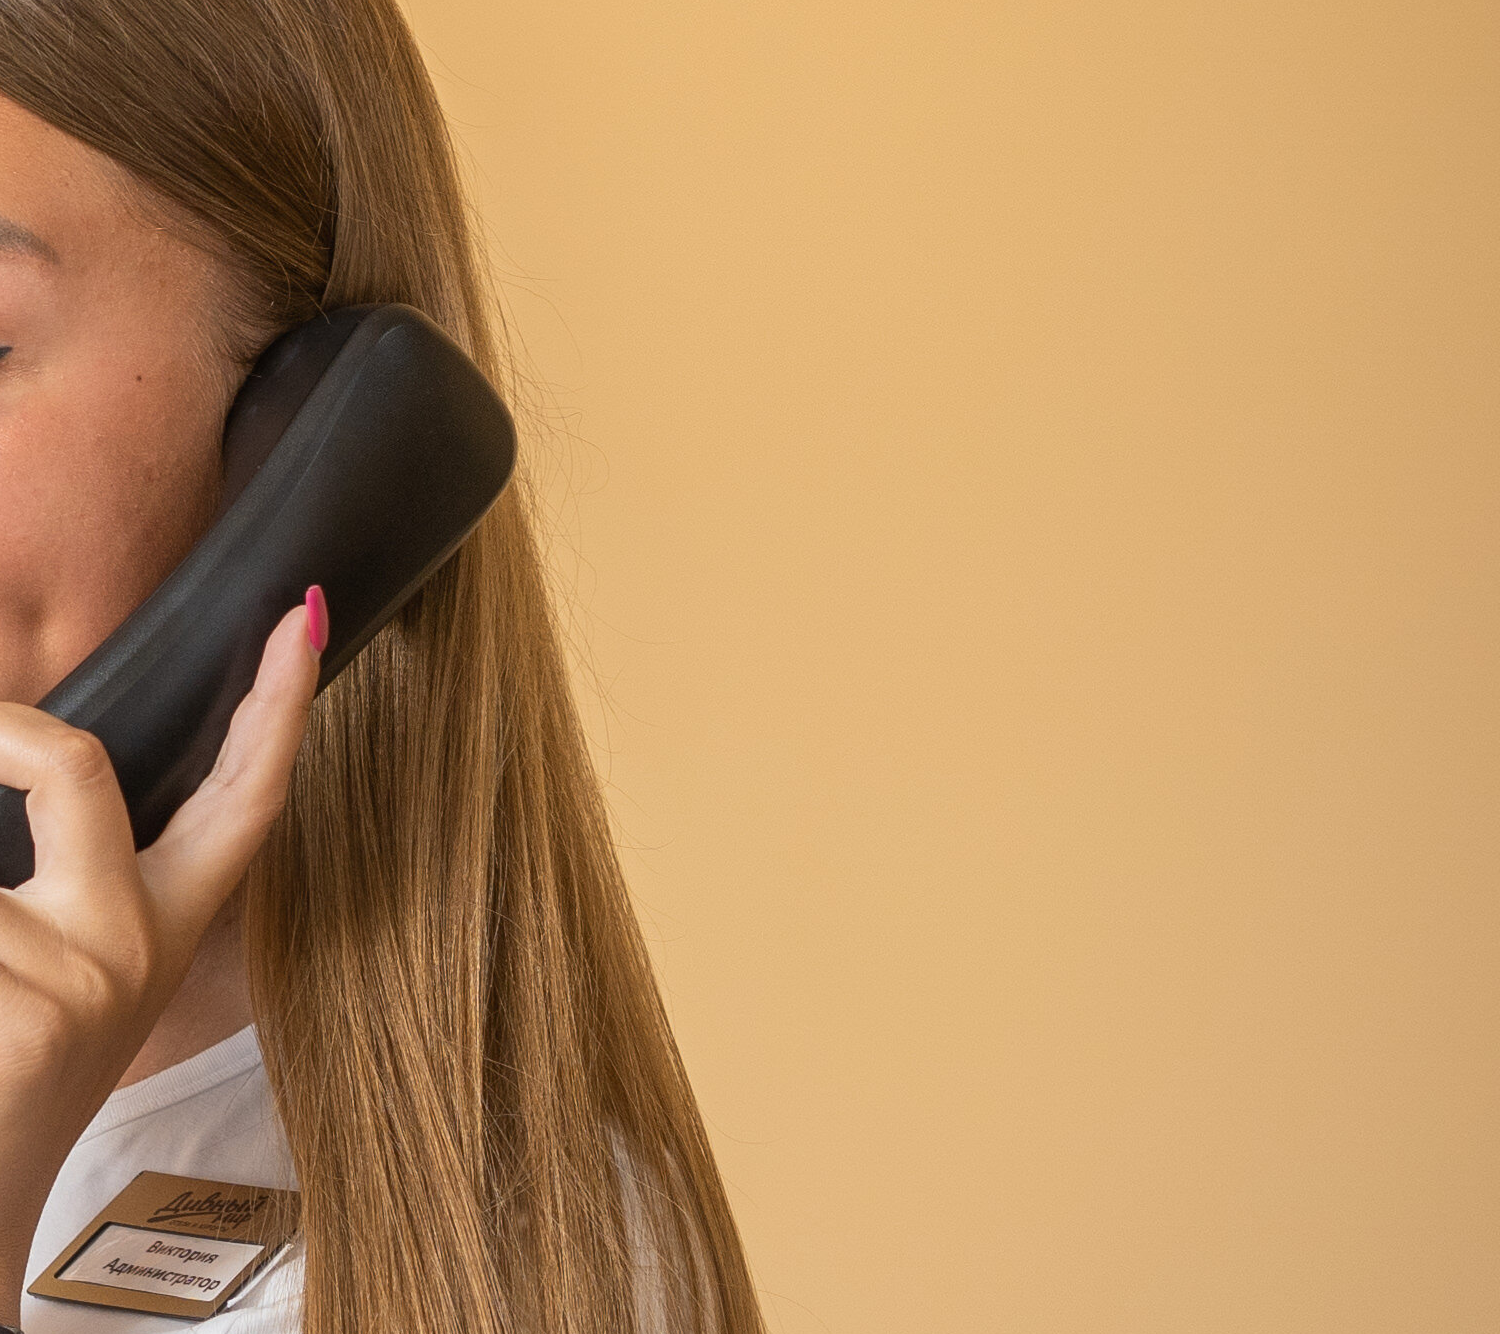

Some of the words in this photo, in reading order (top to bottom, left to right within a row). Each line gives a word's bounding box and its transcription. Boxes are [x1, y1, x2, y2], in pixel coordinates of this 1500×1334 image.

[153, 1191, 270, 1215] Дивный
[146, 1240, 219, 1264] Виктория
[103, 1257, 221, 1292] Администратор
